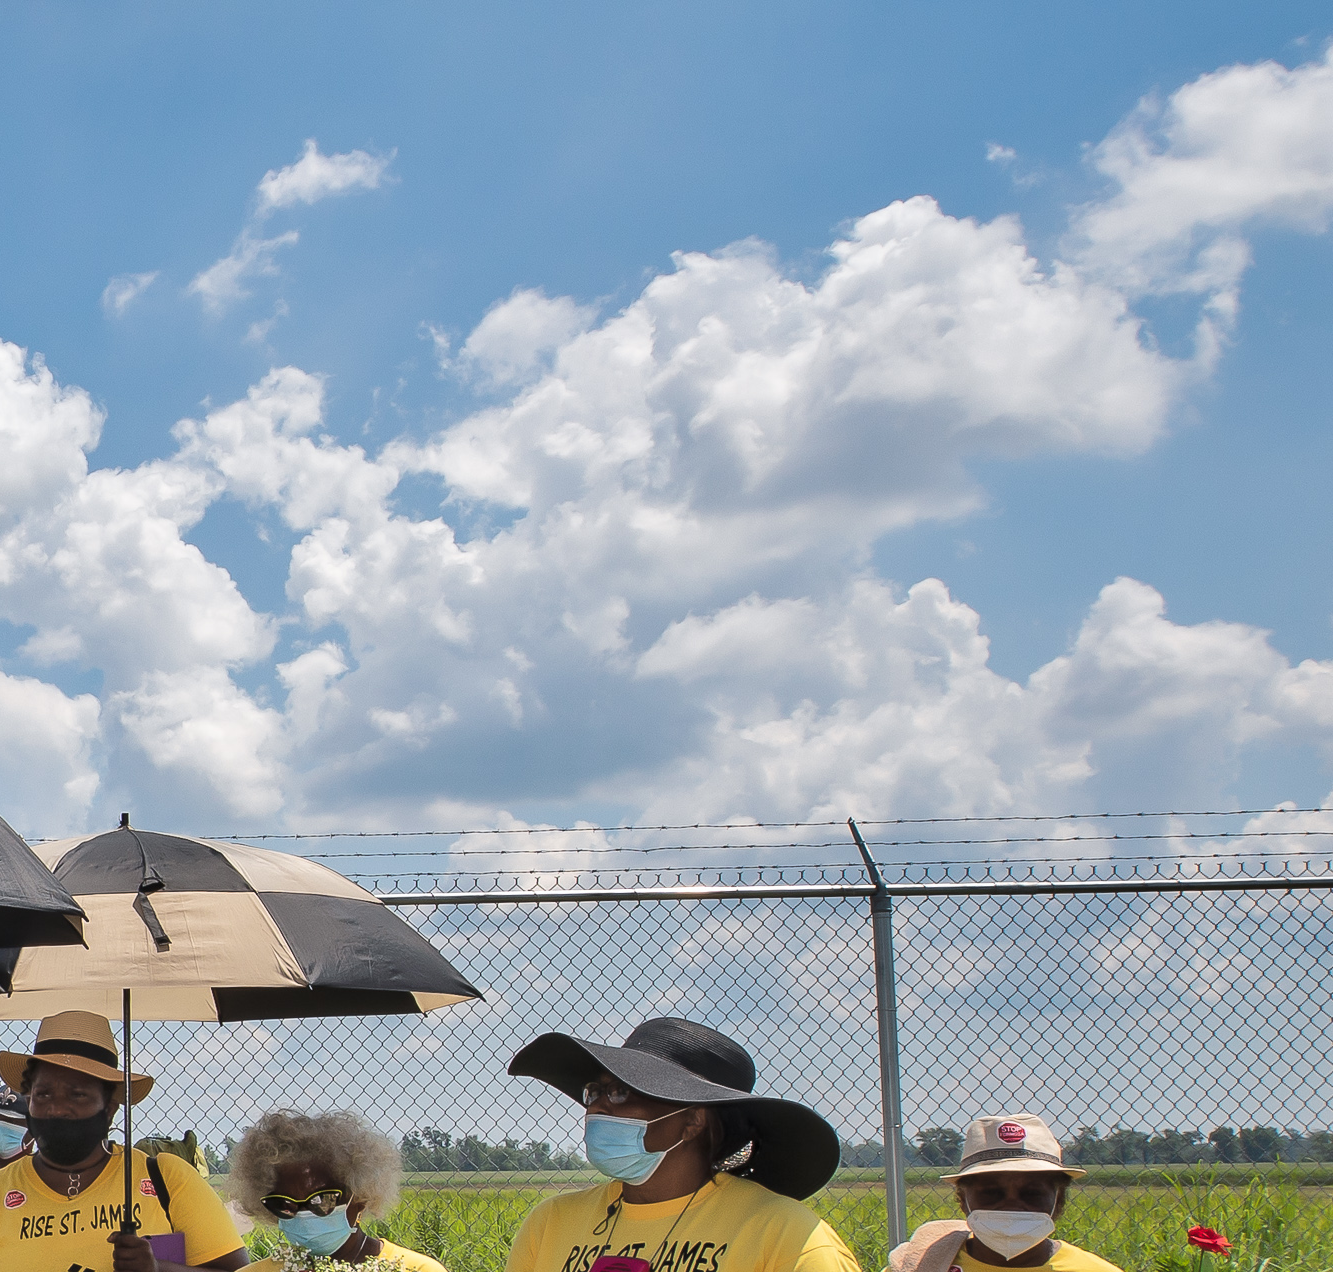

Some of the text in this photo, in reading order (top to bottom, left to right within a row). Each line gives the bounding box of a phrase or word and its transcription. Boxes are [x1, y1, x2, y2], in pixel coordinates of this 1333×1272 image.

[19, 1202, 142, 1240] RISE ST. JAMS
